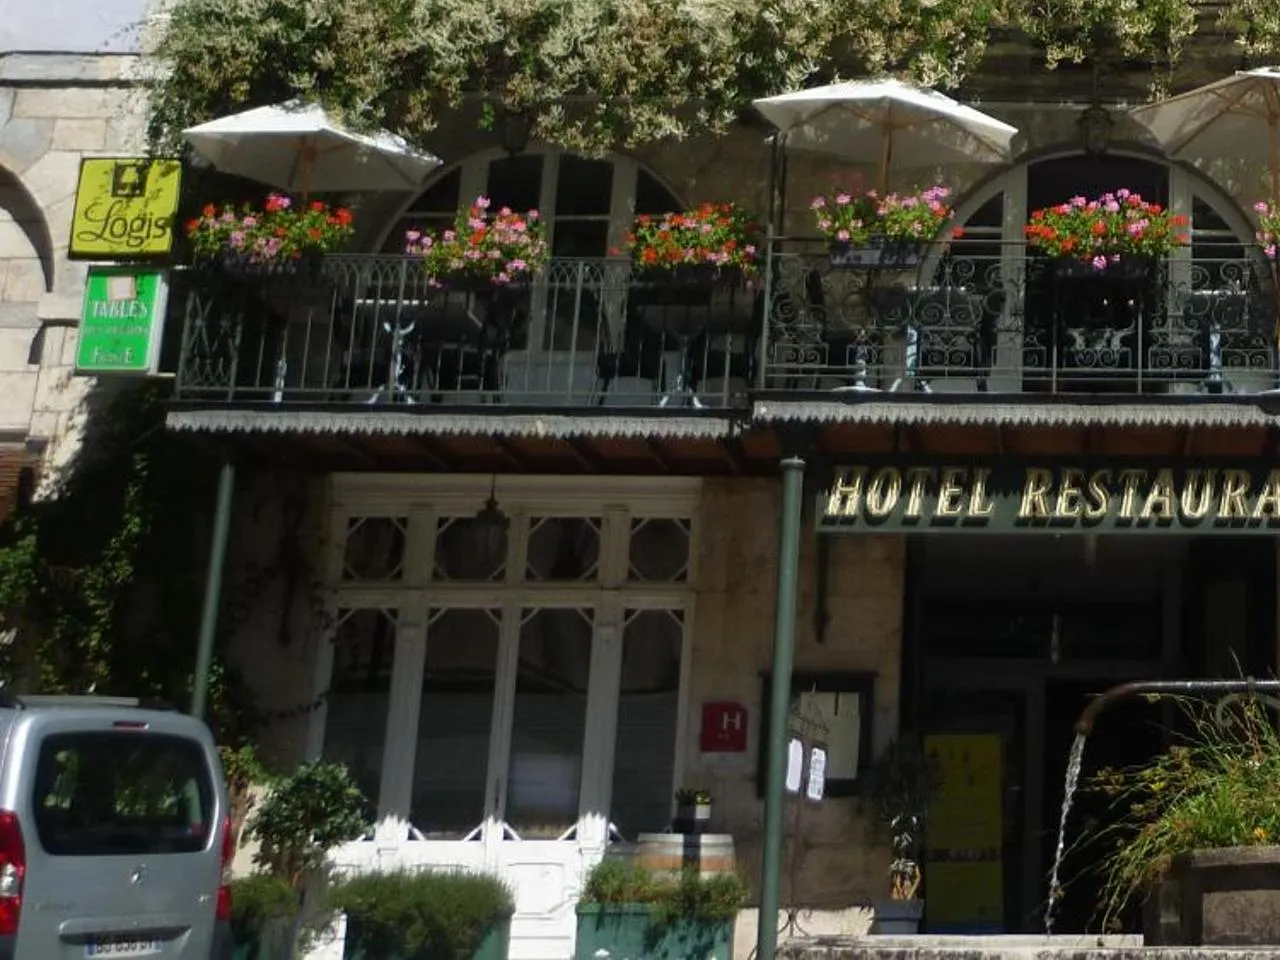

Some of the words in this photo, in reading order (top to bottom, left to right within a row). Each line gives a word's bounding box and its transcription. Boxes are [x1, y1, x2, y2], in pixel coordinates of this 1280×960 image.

[76, 200, 169, 247] Logis
[823, 465, 995, 518] HOTEL
[722, 711, 741, 730] H
